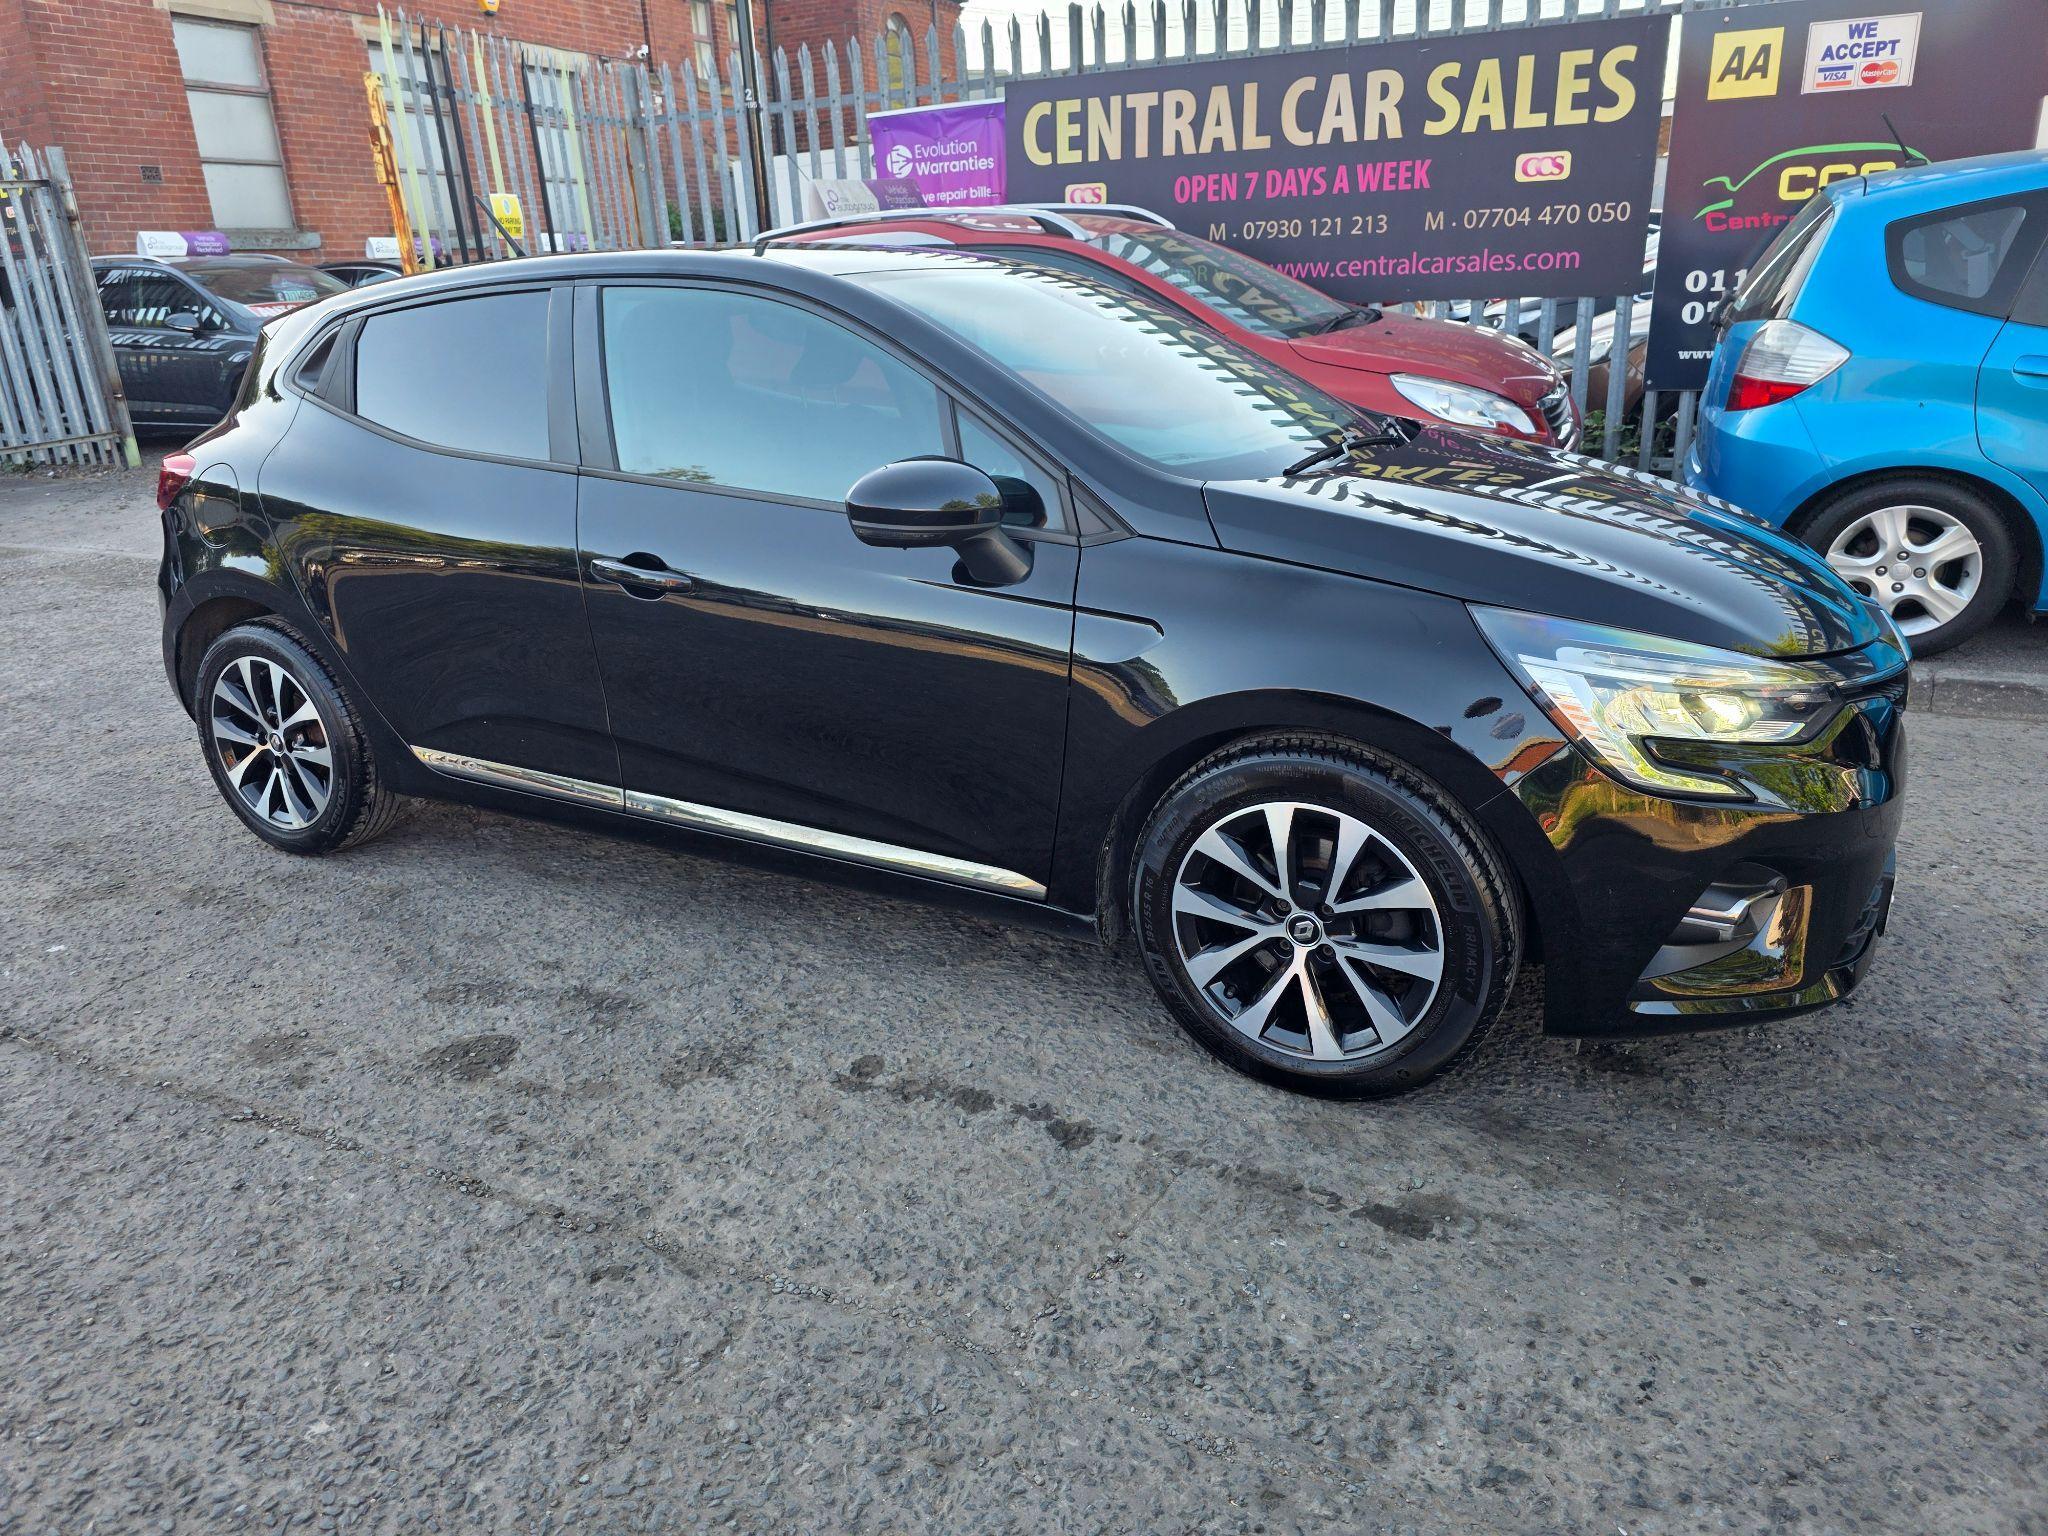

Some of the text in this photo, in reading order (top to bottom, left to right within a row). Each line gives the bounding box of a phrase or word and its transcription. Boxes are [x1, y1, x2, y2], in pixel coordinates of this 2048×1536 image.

[1848, 21, 1879, 39] WE
[1820, 39, 1901, 61] ACCEPT
[1716, 43, 1772, 83] AA
[1860, 69, 1898, 78] MasterCard
[1823, 72, 1847, 81] VISA
[745, 88, 753, 101] 2
[1023, 45, 1639, 167] CENTRAL CAR SALES
[914, 140, 978, 159] Evolution
[915, 156, 995, 177] Warranties
[1521, 155, 1566, 178] CCS
[1174, 159, 1433, 204] OPEN 7 DAYS A WEEK
[936, 188, 968, 204] repair
[1463, 208, 1532, 229] 07704
[1538, 204, 1581, 225] 470
[1587, 201, 1631, 223] 050
[1242, 219, 1302, 240] 07930
[1310, 217, 1342, 237] 121
[1351, 214, 1388, 235] 213
